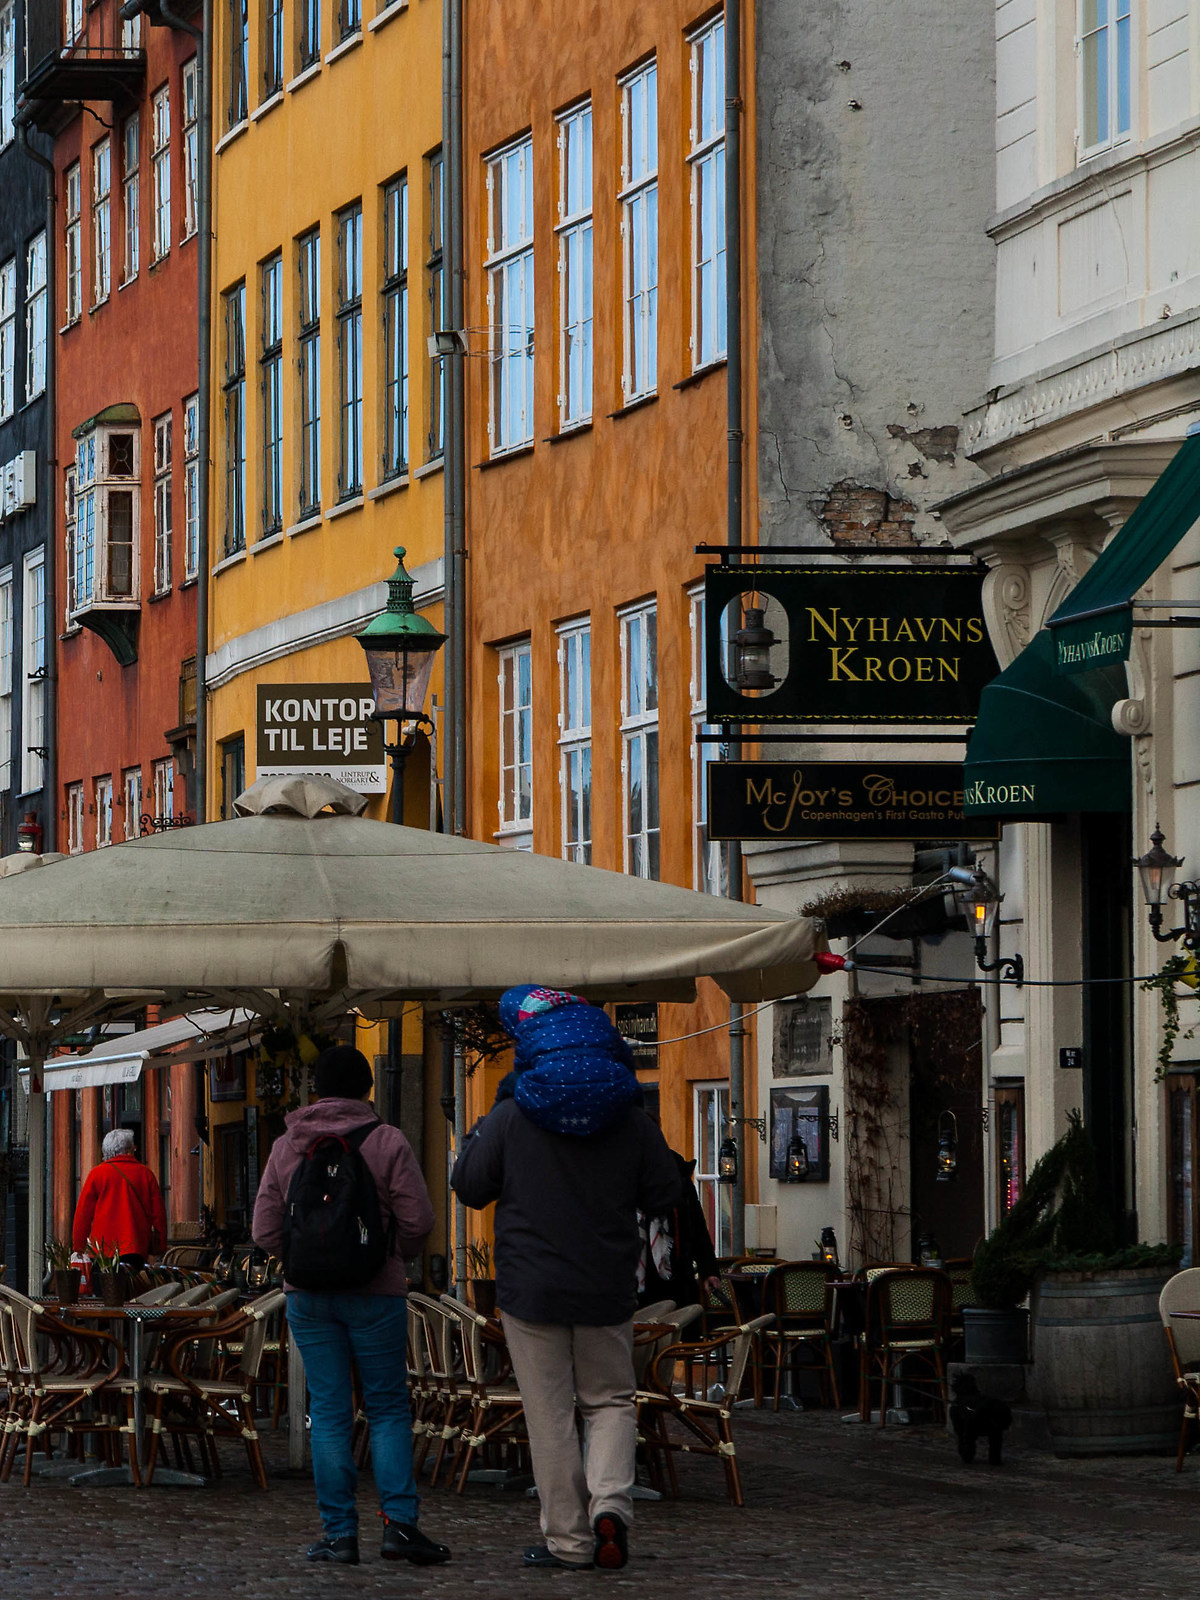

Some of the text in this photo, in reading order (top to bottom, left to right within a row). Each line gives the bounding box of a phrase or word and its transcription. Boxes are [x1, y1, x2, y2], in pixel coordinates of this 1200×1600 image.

[805, 607, 983, 643] NYHAVNS
[827, 647, 960, 682] KROEN
[265, 698, 376, 722] KONTOR
[264, 728, 368, 756] TIL LEJE
[801, 810, 883, 822] Copenhagen's
[885, 809, 906, 820] First
[909, 809, 945, 820] Gastro
